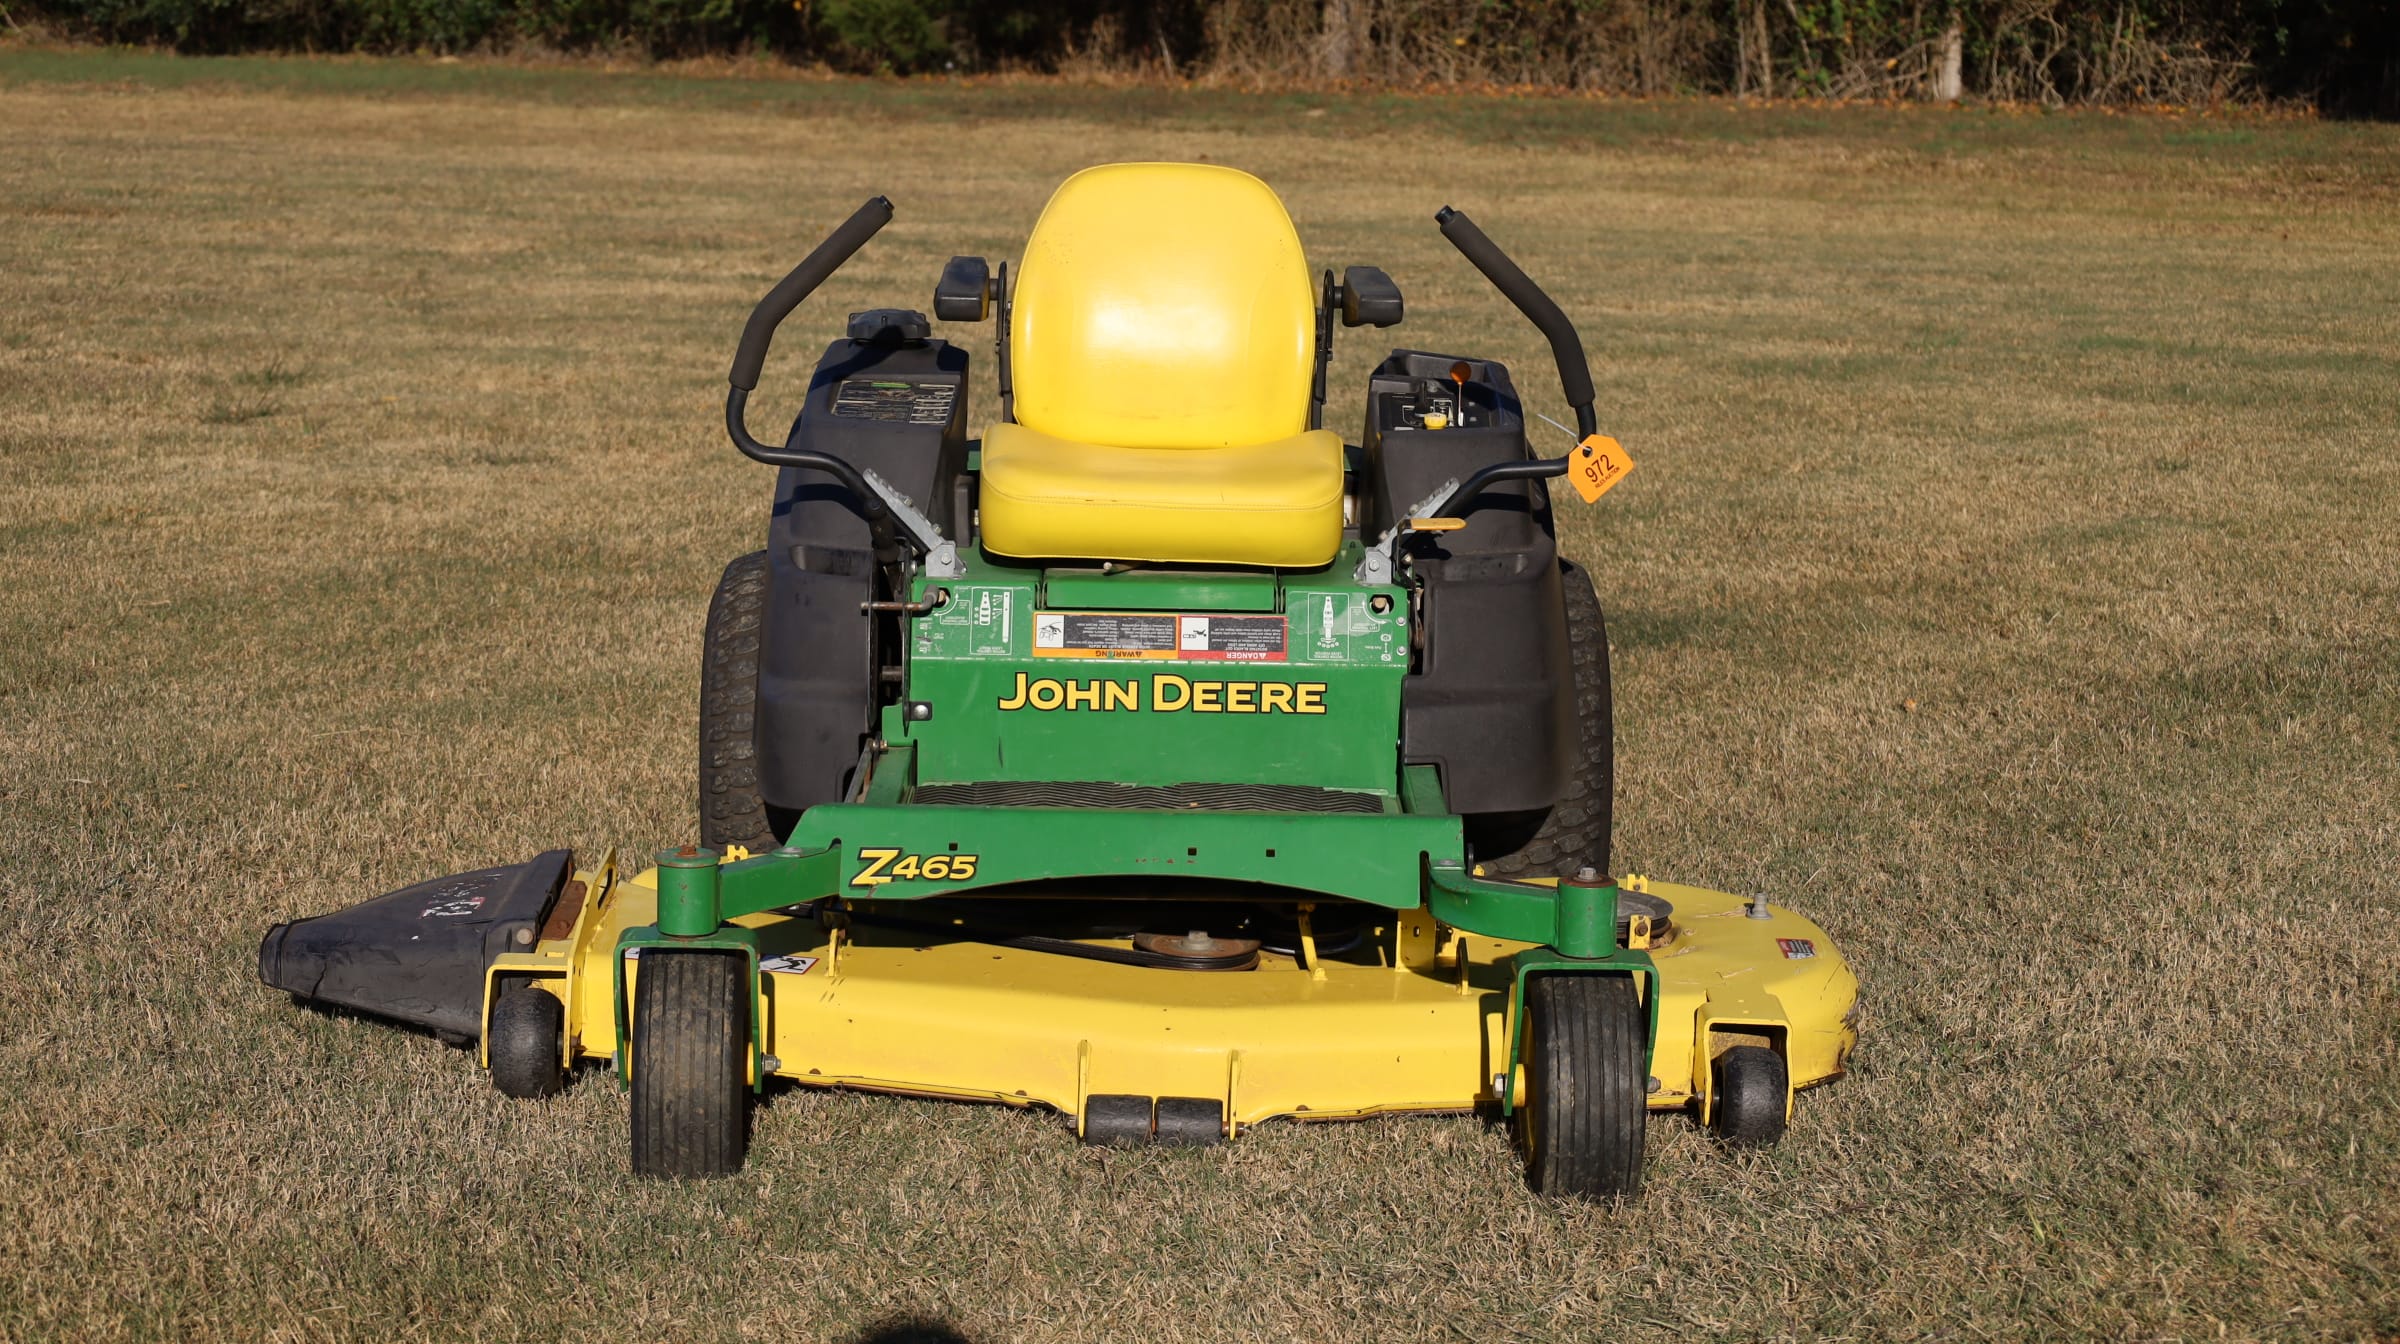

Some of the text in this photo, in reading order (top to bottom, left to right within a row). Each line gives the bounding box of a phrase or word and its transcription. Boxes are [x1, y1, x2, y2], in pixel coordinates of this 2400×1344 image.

[1585, 454, 1614, 482] 972
[1227, 651, 1258, 659] DANGER
[998, 672, 1327, 714] JOHN DEERE
[849, 847, 979, 887] Z465
